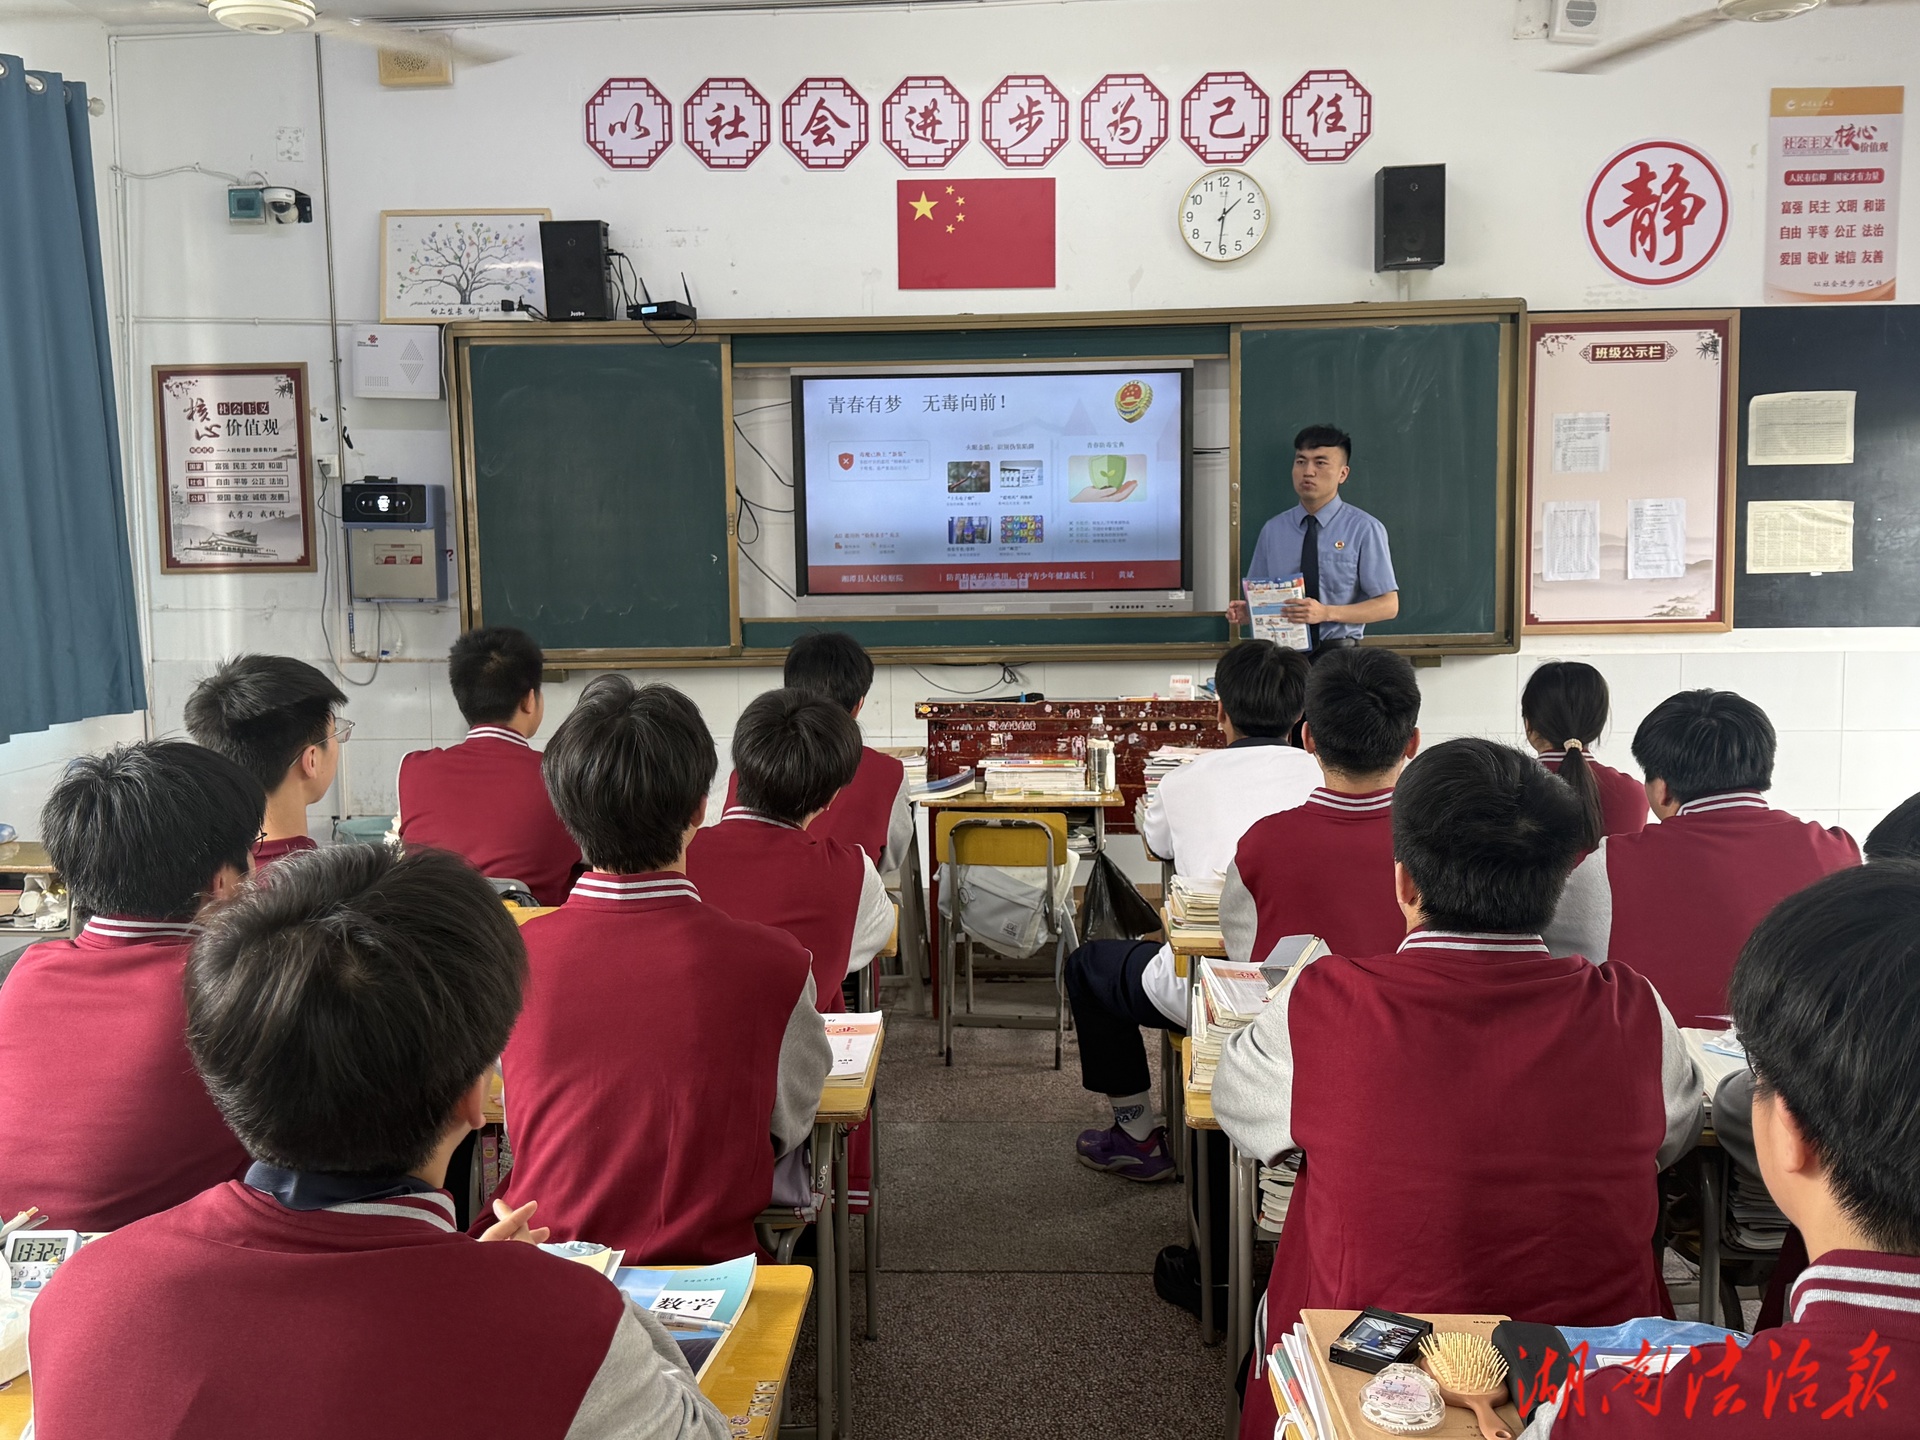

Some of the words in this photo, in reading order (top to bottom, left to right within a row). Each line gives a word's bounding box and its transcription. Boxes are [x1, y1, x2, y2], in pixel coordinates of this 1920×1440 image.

[608, 93, 1347, 149] 以社会进步为己任
[1783, 136, 1834, 150] 社会主义
[1835, 124, 1878, 151] 核心
[1860, 142, 1888, 153] 价值观
[1218, 176, 1230, 187] 12
[1789, 173, 1827, 183] 人民有信仰
[1833, 172, 1880, 182] 国家才有力量
[1204, 181, 1213, 192] 11
[1237, 180, 1242, 190] 1
[1190, 194, 1202, 205] 10
[1247, 193, 1255, 203] 2
[1781, 201, 1803, 215] 富强
[1809, 200, 1830, 213] 民主
[1836, 200, 1857, 213] 文明
[1864, 199, 1885, 213] 和谐
[1186, 211, 1193, 222] 9
[1253, 209, 1260, 220] 3
[1603, 161, 1706, 266] 静
[1192, 228, 1199, 239] 8
[1247, 227, 1254, 237] 4
[1780, 226, 1801, 239] 自由
[1807, 225, 1829, 238] 平等
[1835, 225, 1856, 238] 公正
[1862, 224, 1884, 237] 法治
[1204, 241, 1211, 252] 7
[1219, 244, 1227, 255] 6
[1234, 240, 1242, 251] 5
[1780, 252, 1801, 265] 爱国
[1807, 251, 1829, 265] 敬业
[1835, 251, 1856, 264] 诚信
[1862, 250, 1884, 264] 友善
[1595, 346, 1662, 359] 班级公示栏
[218, 402, 269, 415] 社会主义
[828, 395, 902, 414] 青春有梦
[183, 398, 221, 441] 核心
[225, 418, 280, 437] 价值观
[252, 477, 266, 485] 公正
[657, 1296, 716, 1311] 数学
